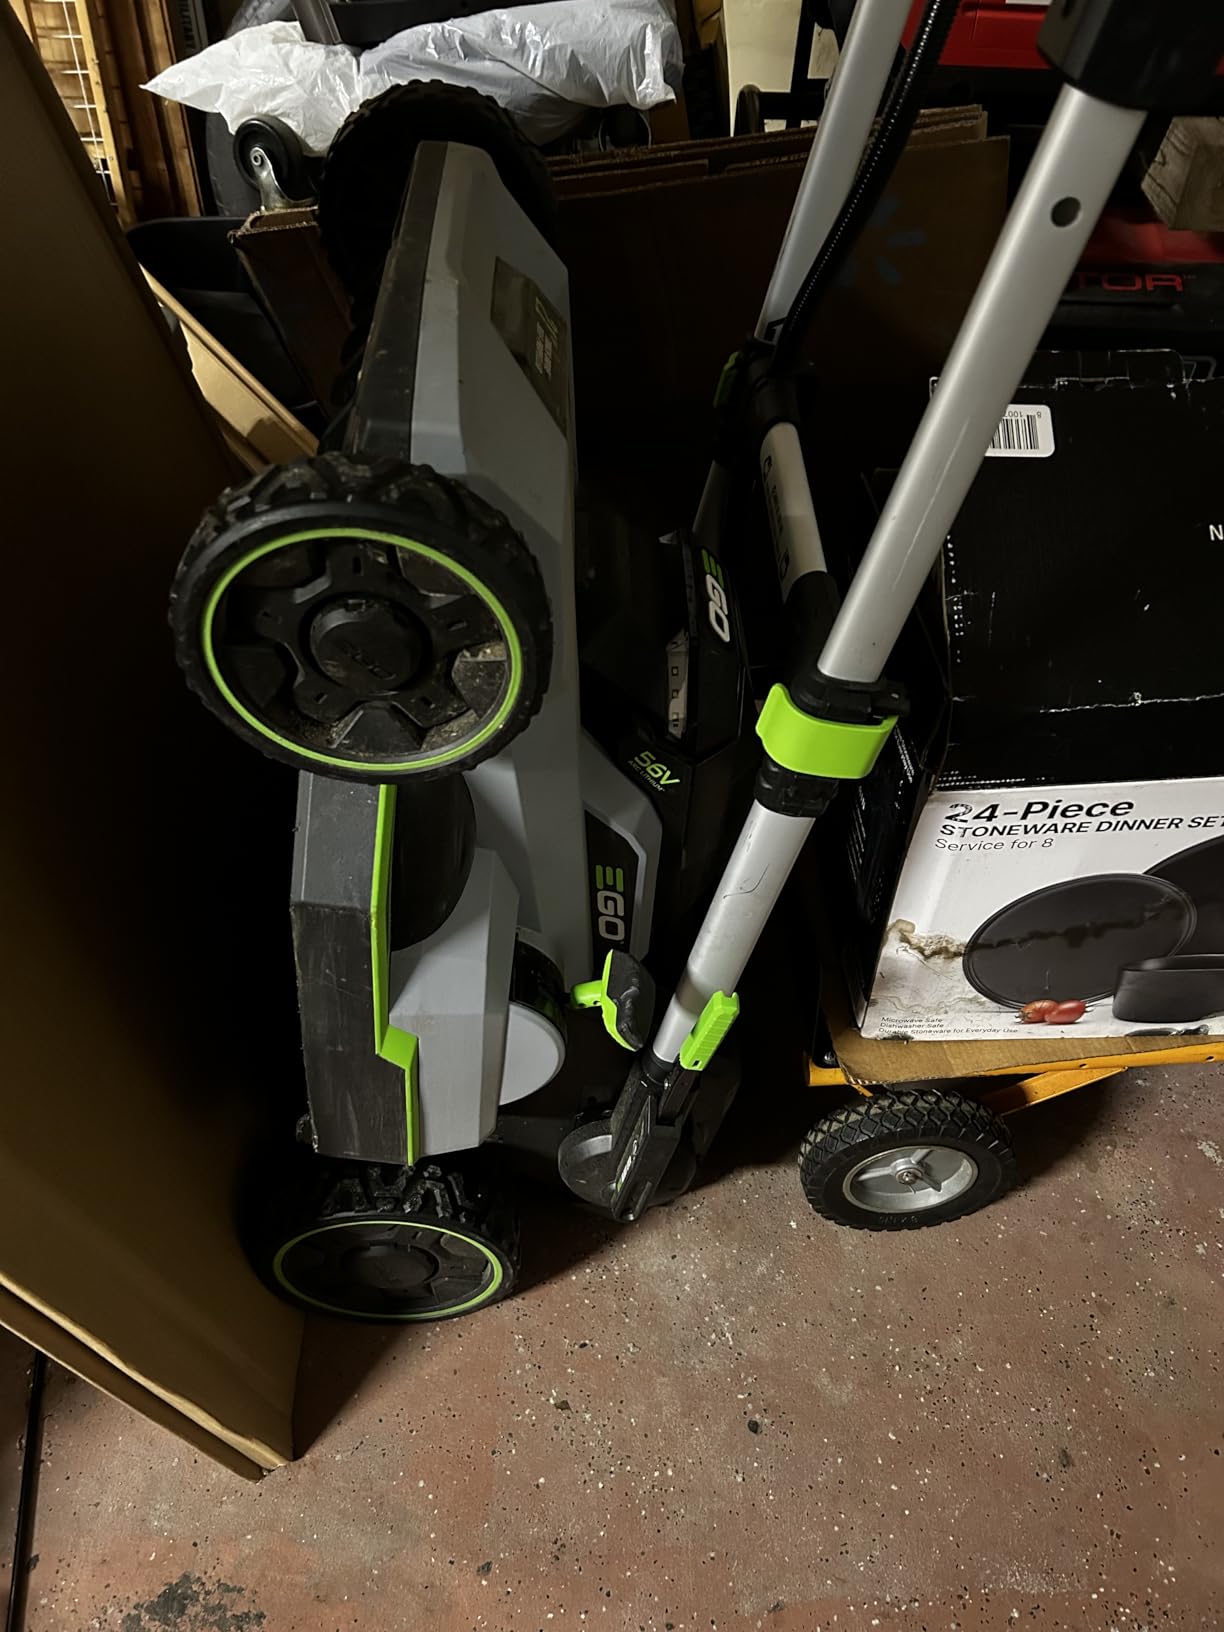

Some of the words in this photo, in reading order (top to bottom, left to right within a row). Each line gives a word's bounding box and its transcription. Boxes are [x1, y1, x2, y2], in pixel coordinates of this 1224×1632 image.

[701, 548, 730, 643] EGO
[633, 751, 681, 785] 56V
[944, 799, 1134, 823] 24-Piece
[939, 821, 1093, 838] STONEWARE
[1095, 818, 1184, 833] DINNER
[934, 838, 1005, 852] Service
[1010, 838, 1037, 850] for
[1041, 837, 1054, 849] 8
[595, 863, 626, 942] EGO
[881, 1016, 923, 1024] Microwave
